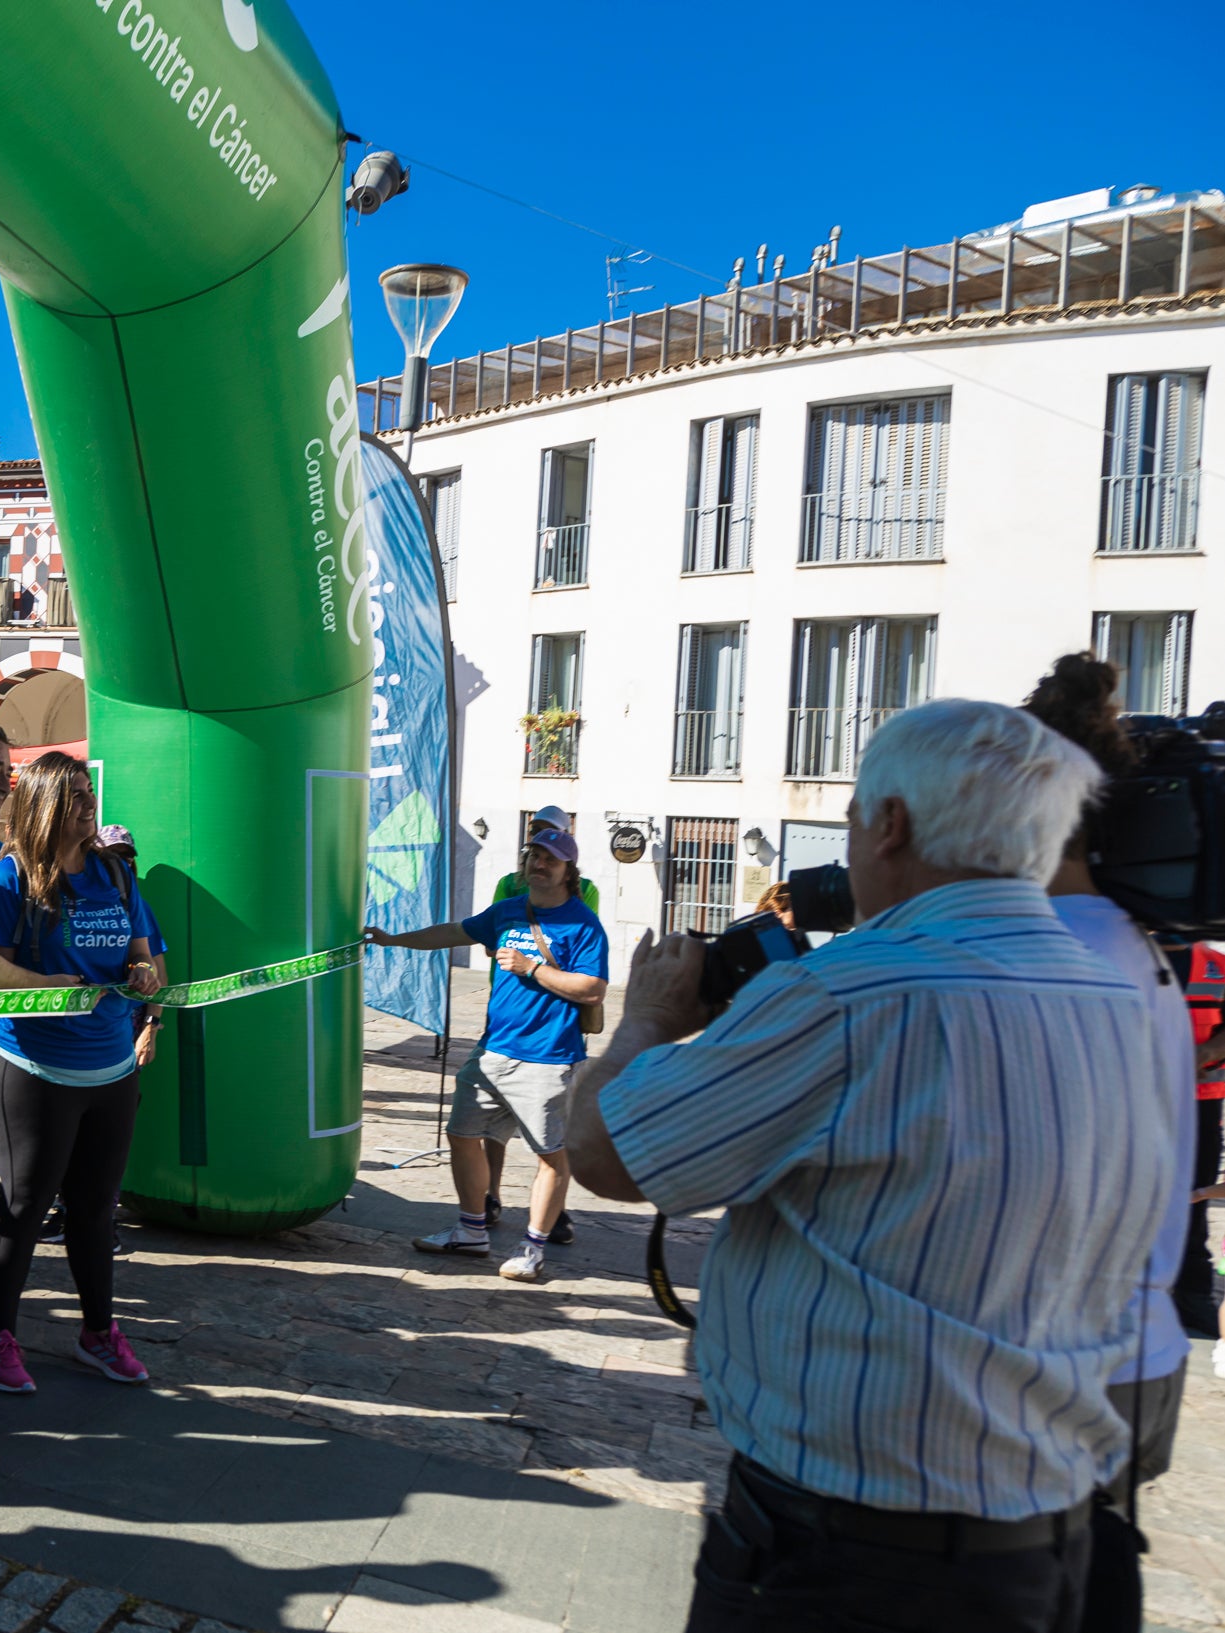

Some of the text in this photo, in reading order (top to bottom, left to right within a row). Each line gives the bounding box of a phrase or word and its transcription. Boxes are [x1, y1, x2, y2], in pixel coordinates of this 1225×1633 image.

[117, 0, 278, 202] contra el Cáncer
[304, 438, 337, 633] Contra el Cáncer
[73, 918, 119, 929] contra
